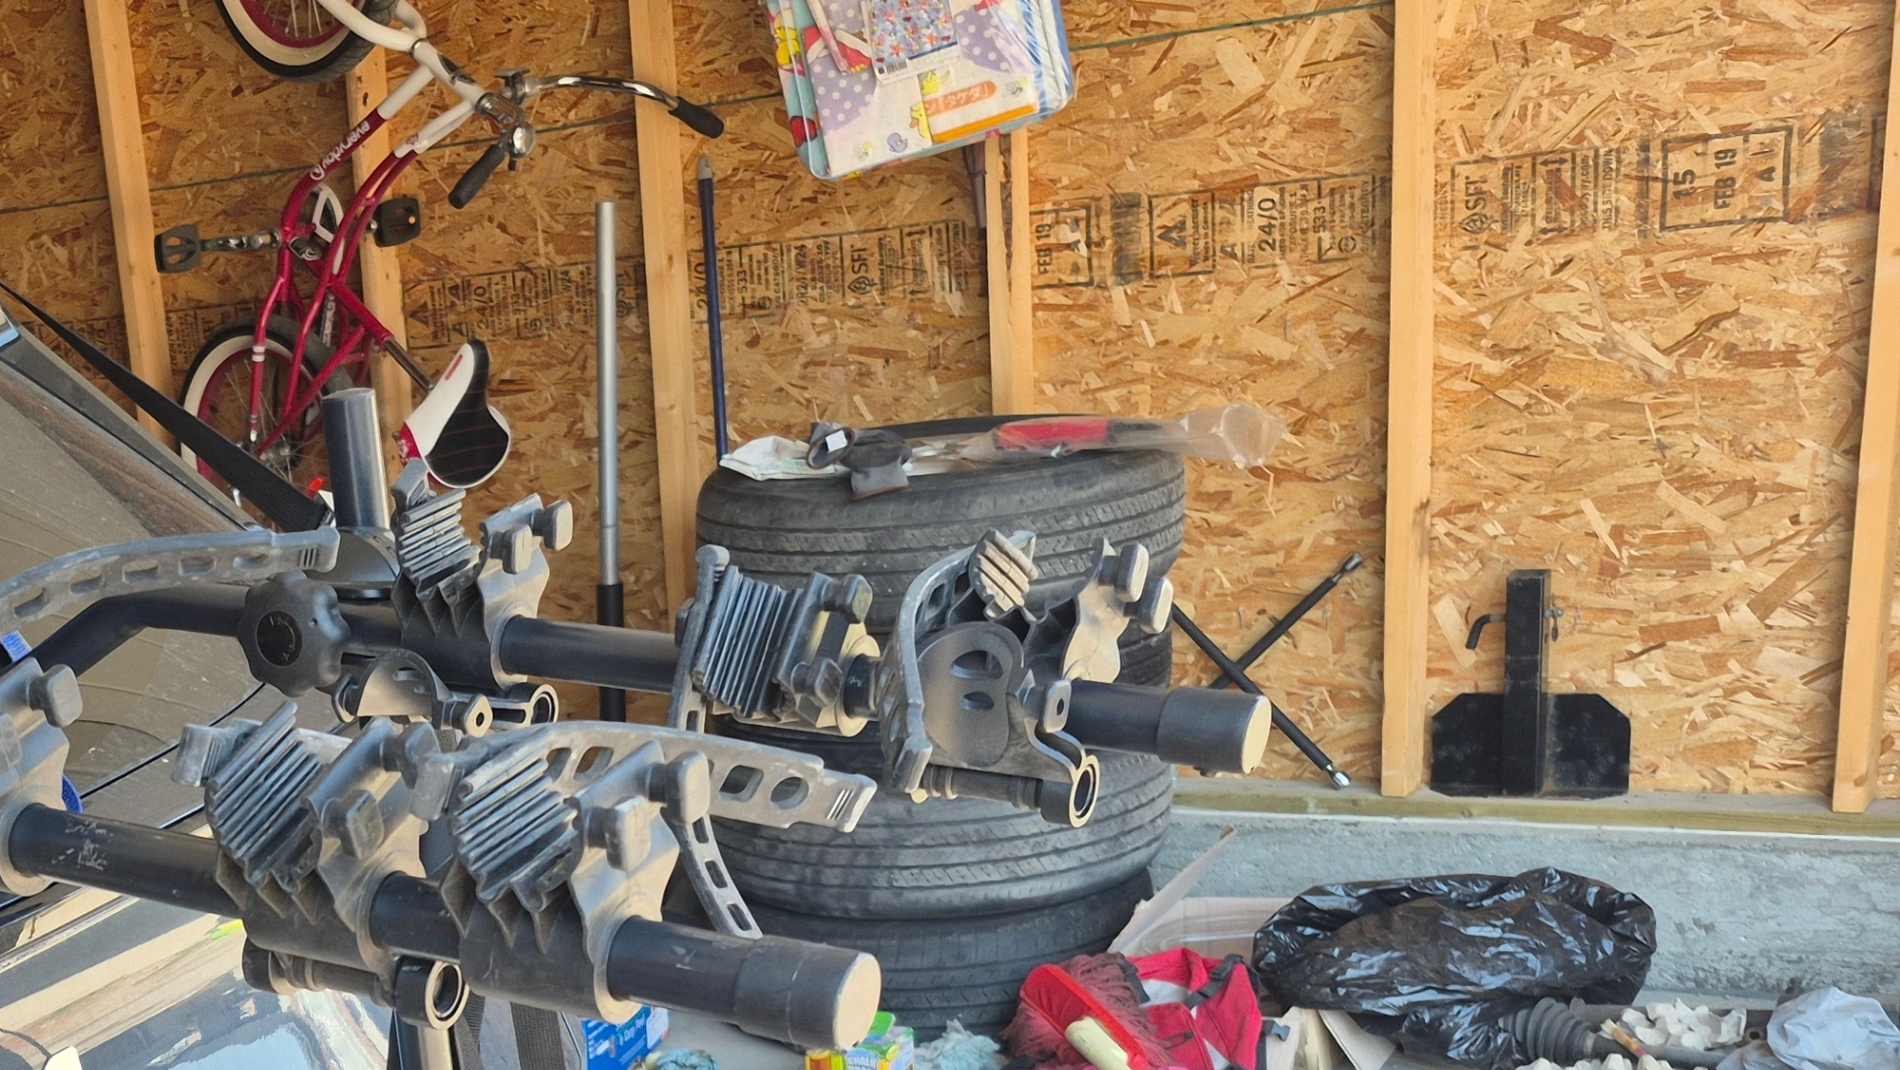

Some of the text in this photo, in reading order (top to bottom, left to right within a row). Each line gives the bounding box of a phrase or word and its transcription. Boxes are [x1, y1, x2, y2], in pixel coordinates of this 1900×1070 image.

[1671, 169, 1697, 200] 15
[1713, 149, 1737, 210] FEB 19
[1257, 197, 1278, 252] 24/0
[1312, 205, 1326, 234] 533
[1035, 247, 1053, 276] FEB
[737, 270, 748, 294] 533
[473, 285, 489, 330] 24/0
